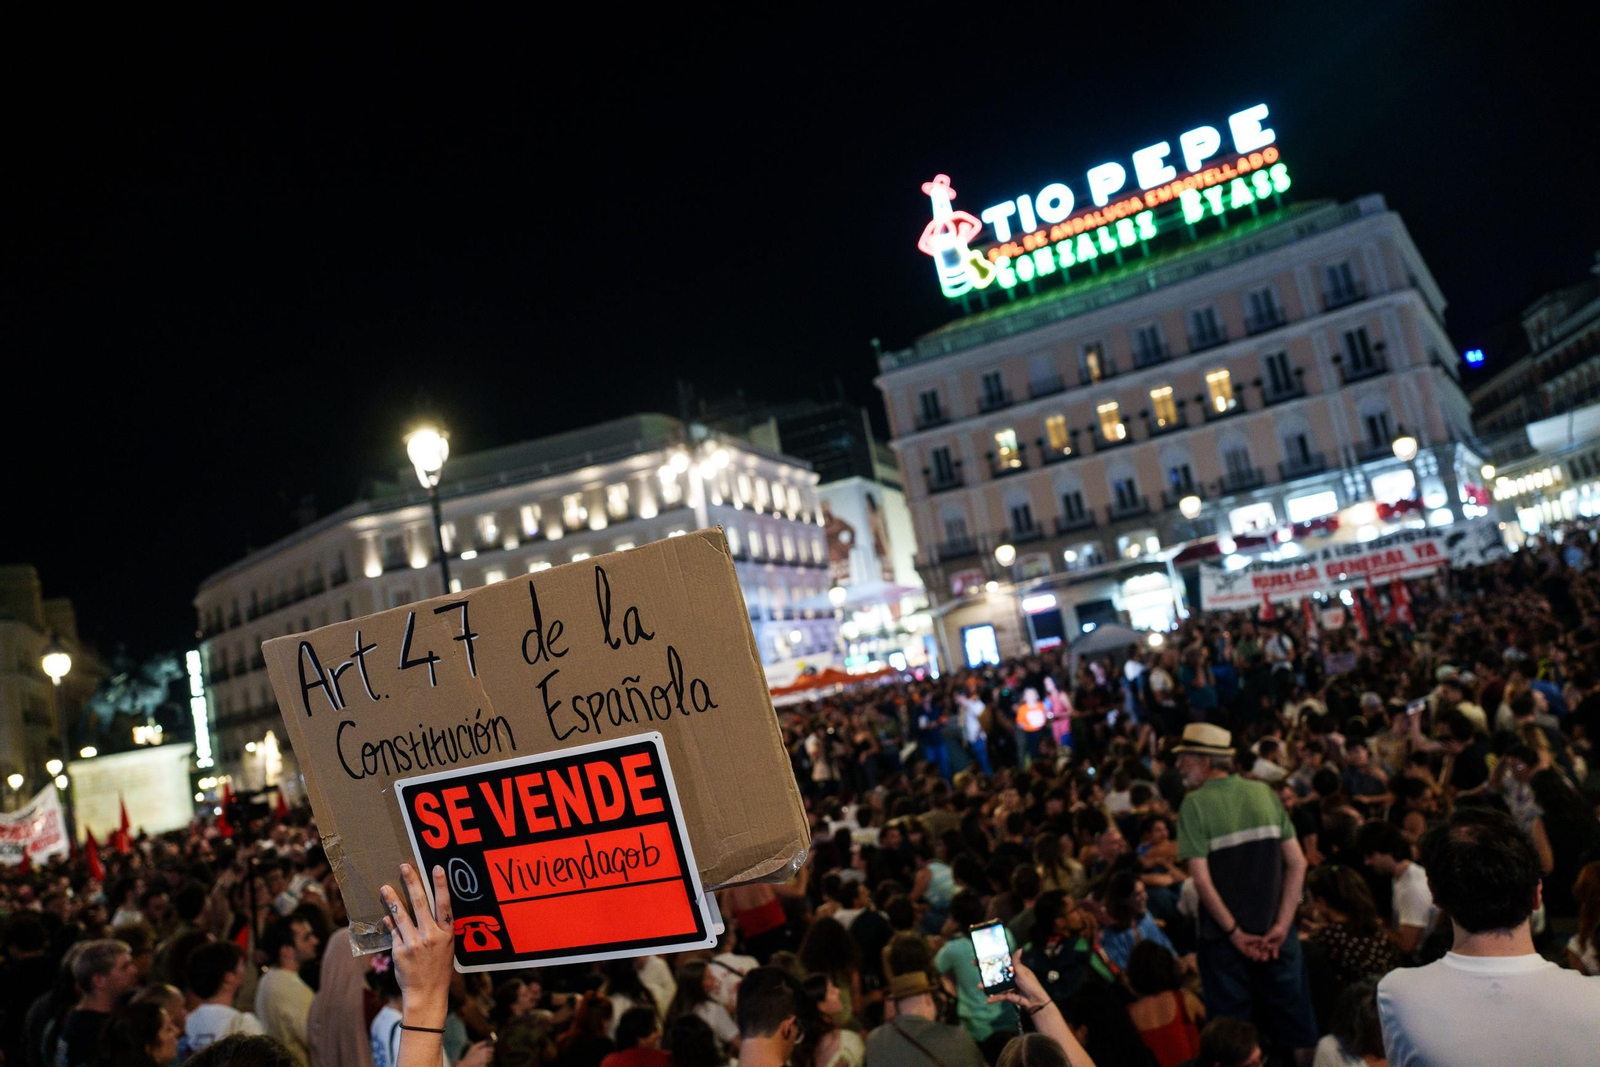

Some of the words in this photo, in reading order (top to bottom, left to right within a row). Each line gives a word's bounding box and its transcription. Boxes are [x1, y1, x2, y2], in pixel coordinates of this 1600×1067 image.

[982, 183, 1074, 242] TIO
[1087, 104, 1276, 207] PEPE
[995, 211, 1157, 289] GONZALEZ
[1180, 163, 1291, 224] BYASS
[1023, 230, 1048, 251] DE
[1144, 147, 1279, 207] EMBOTELLADO
[1325, 549, 1406, 580] GENERAL
[1413, 541, 1439, 561] YA
[297, 629, 391, 717] Art.
[398, 600, 479, 687] 47
[522, 580, 570, 666] de
[595, 565, 655, 651] la
[336, 709, 517, 779] Constitución
[536, 645, 719, 741] Española
[413, 785, 483, 851] SE
[478, 751, 665, 838] VENDE
